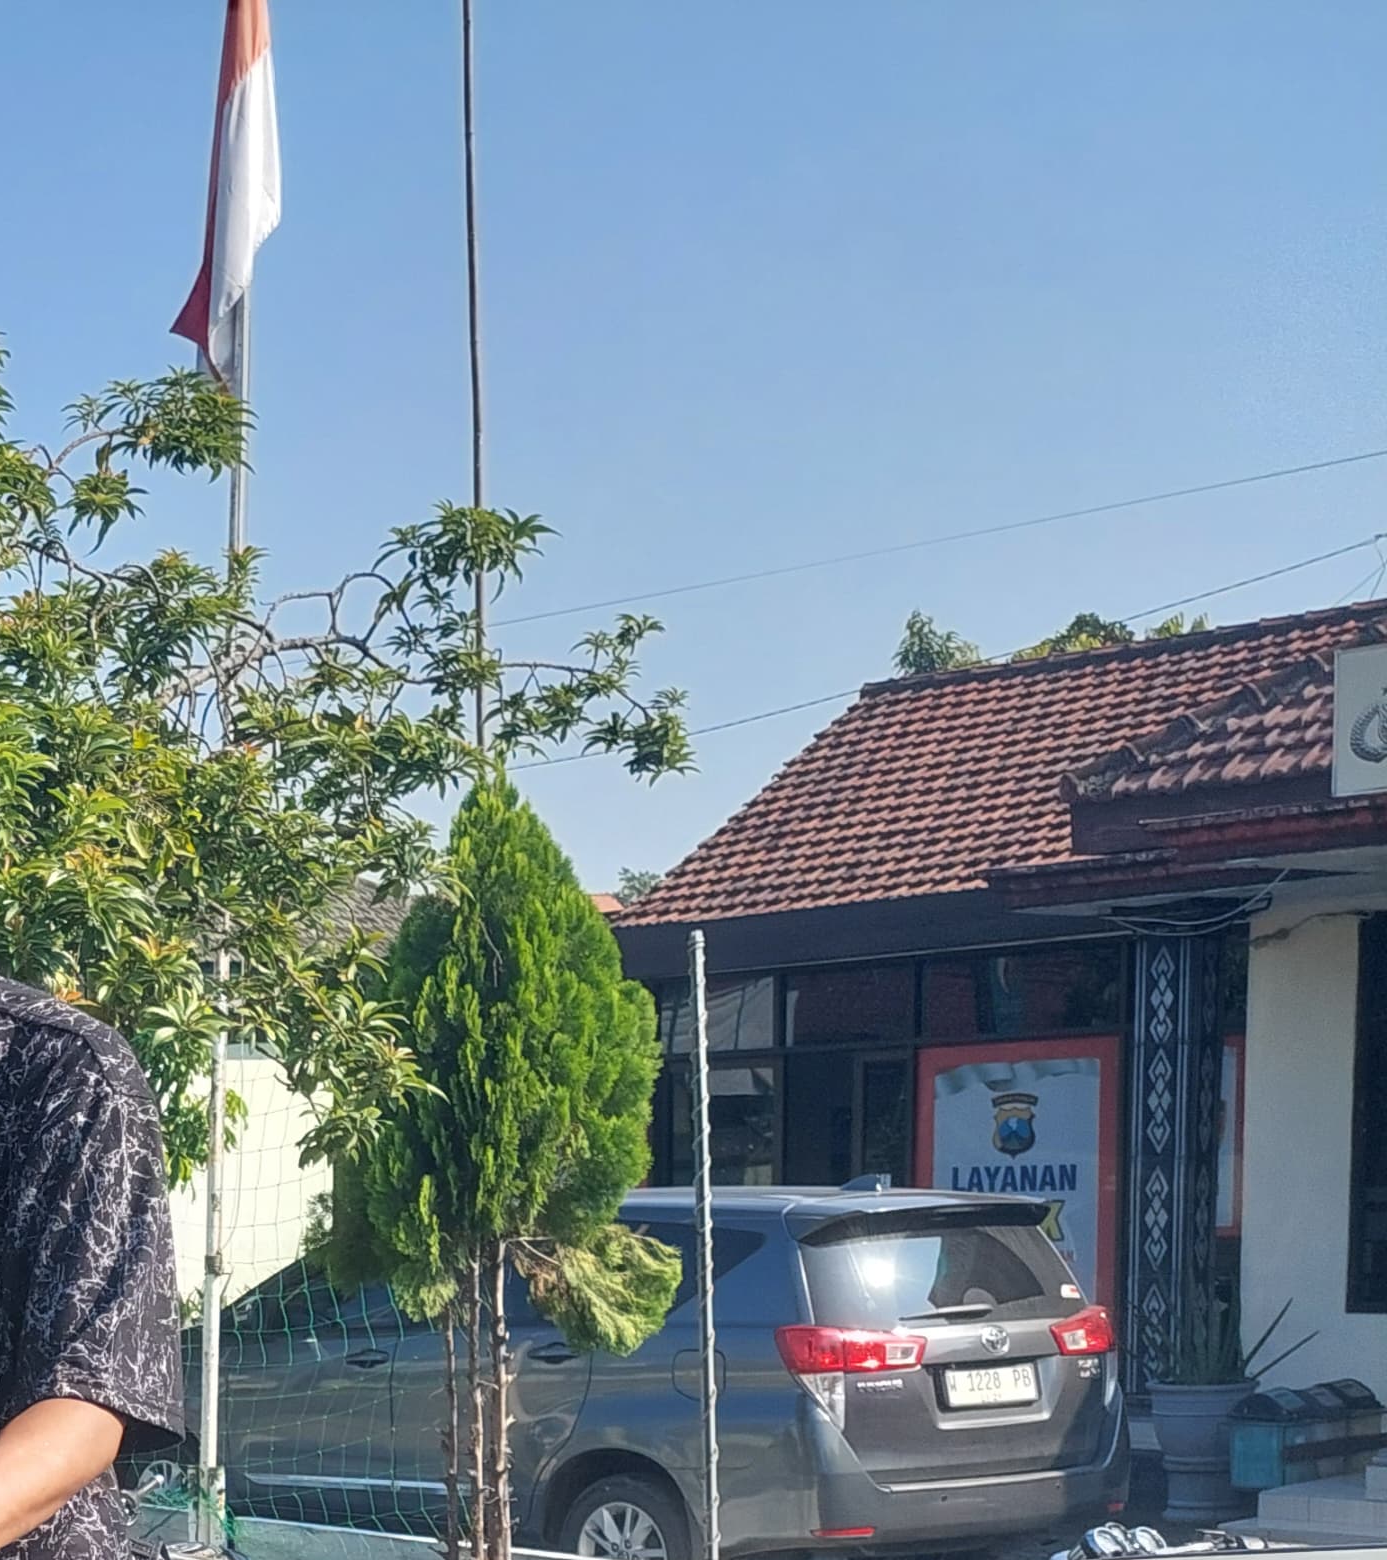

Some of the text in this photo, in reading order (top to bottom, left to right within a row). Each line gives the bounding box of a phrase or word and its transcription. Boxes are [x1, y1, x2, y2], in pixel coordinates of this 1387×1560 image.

[951, 1164, 1077, 1192] LAYANAN
[966, 1371, 1001, 1393] 1228
[1012, 1368, 1032, 1389] PB
